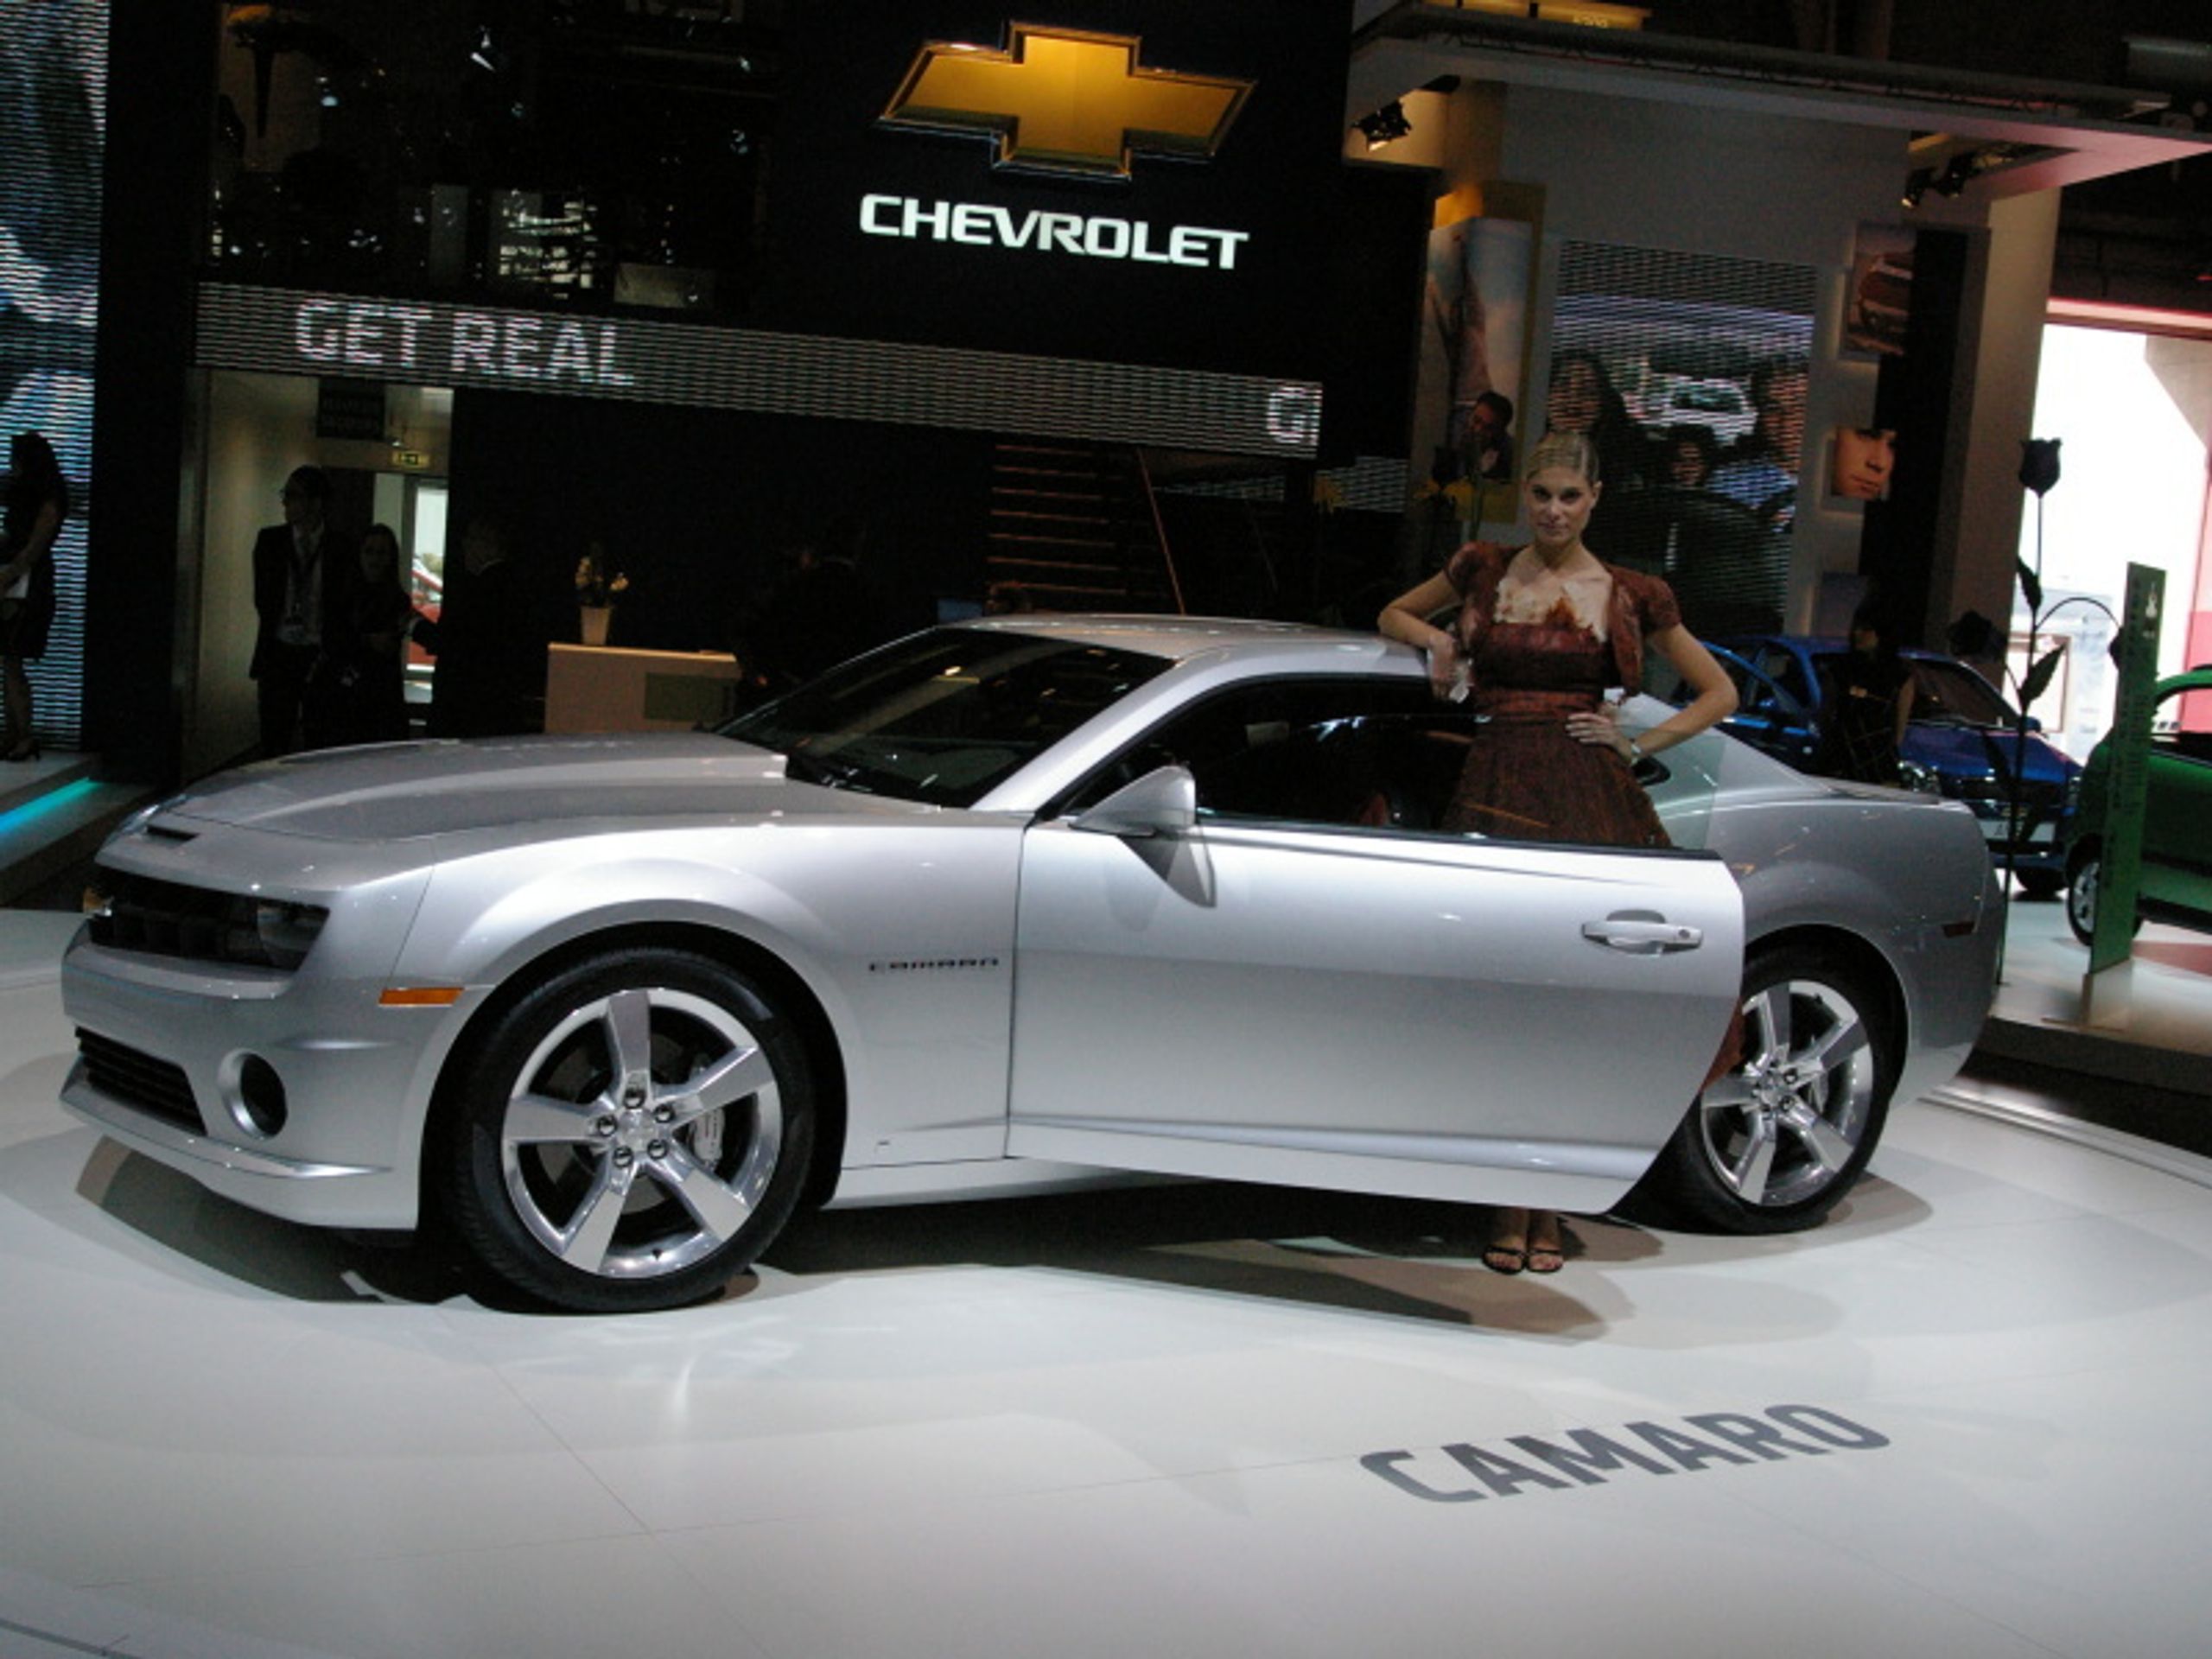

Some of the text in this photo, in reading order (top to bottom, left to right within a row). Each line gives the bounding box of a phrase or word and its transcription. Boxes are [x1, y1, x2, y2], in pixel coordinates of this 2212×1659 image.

[860, 193, 1250, 270] CHEVROLET
[296, 298, 635, 386] GET REAL
[1266, 386, 1322, 446] G
[1358, 1404, 1891, 1503] CAMARO
